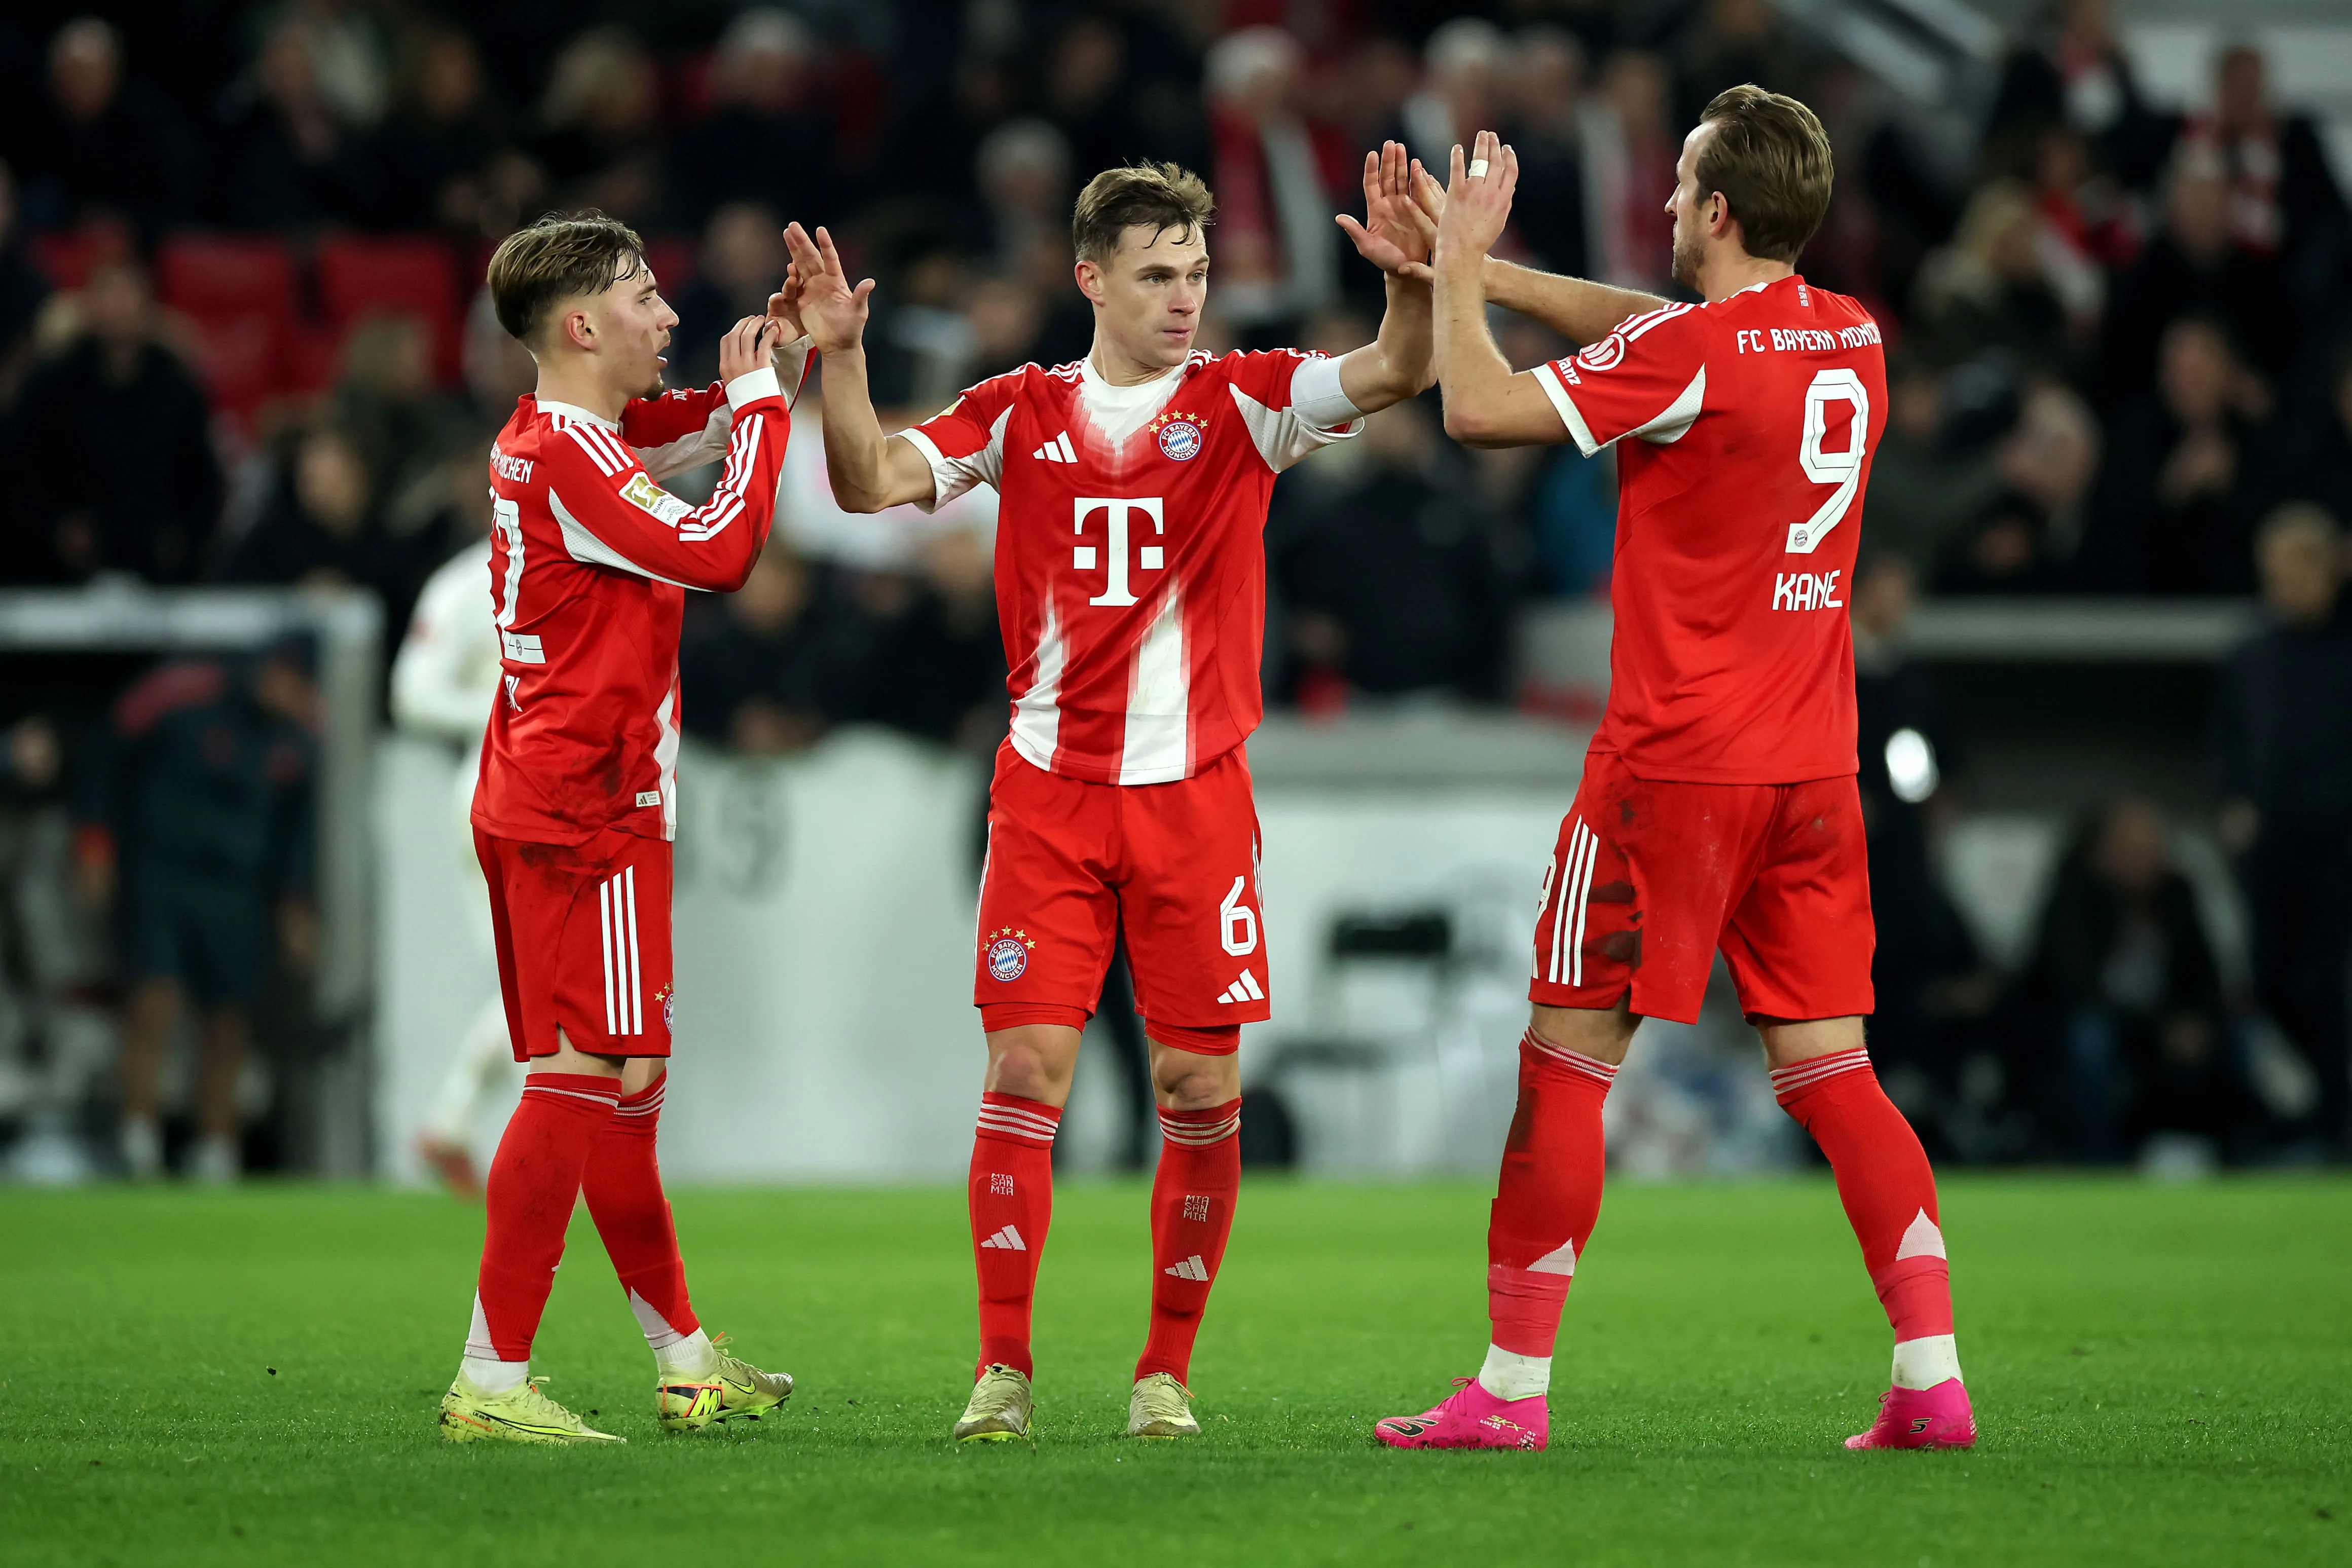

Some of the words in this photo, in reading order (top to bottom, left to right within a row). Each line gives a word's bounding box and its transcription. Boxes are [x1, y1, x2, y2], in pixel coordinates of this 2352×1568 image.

[1737, 329, 1765, 354] FC
[1770, 328, 1836, 351] BAYERN
[1162, 431, 1170, 440] FC
[1169, 425, 1197, 438] BAYERN
[1785, 368, 1869, 553] 9
[1074, 497, 1164, 606] T
[1772, 569, 1843, 611] KANE
[1220, 875, 1258, 957] 6
[991, 948, 998, 958] FC
[998, 942, 1023, 957] BAYERN
[991, 1178, 1013, 1187] SAN
[990, 1185, 1013, 1196] MIA
[1186, 1194, 1209, 1205] MIA
[1185, 1202, 1207, 1213] SAN
[1184, 1209, 1206, 1222] MIA
